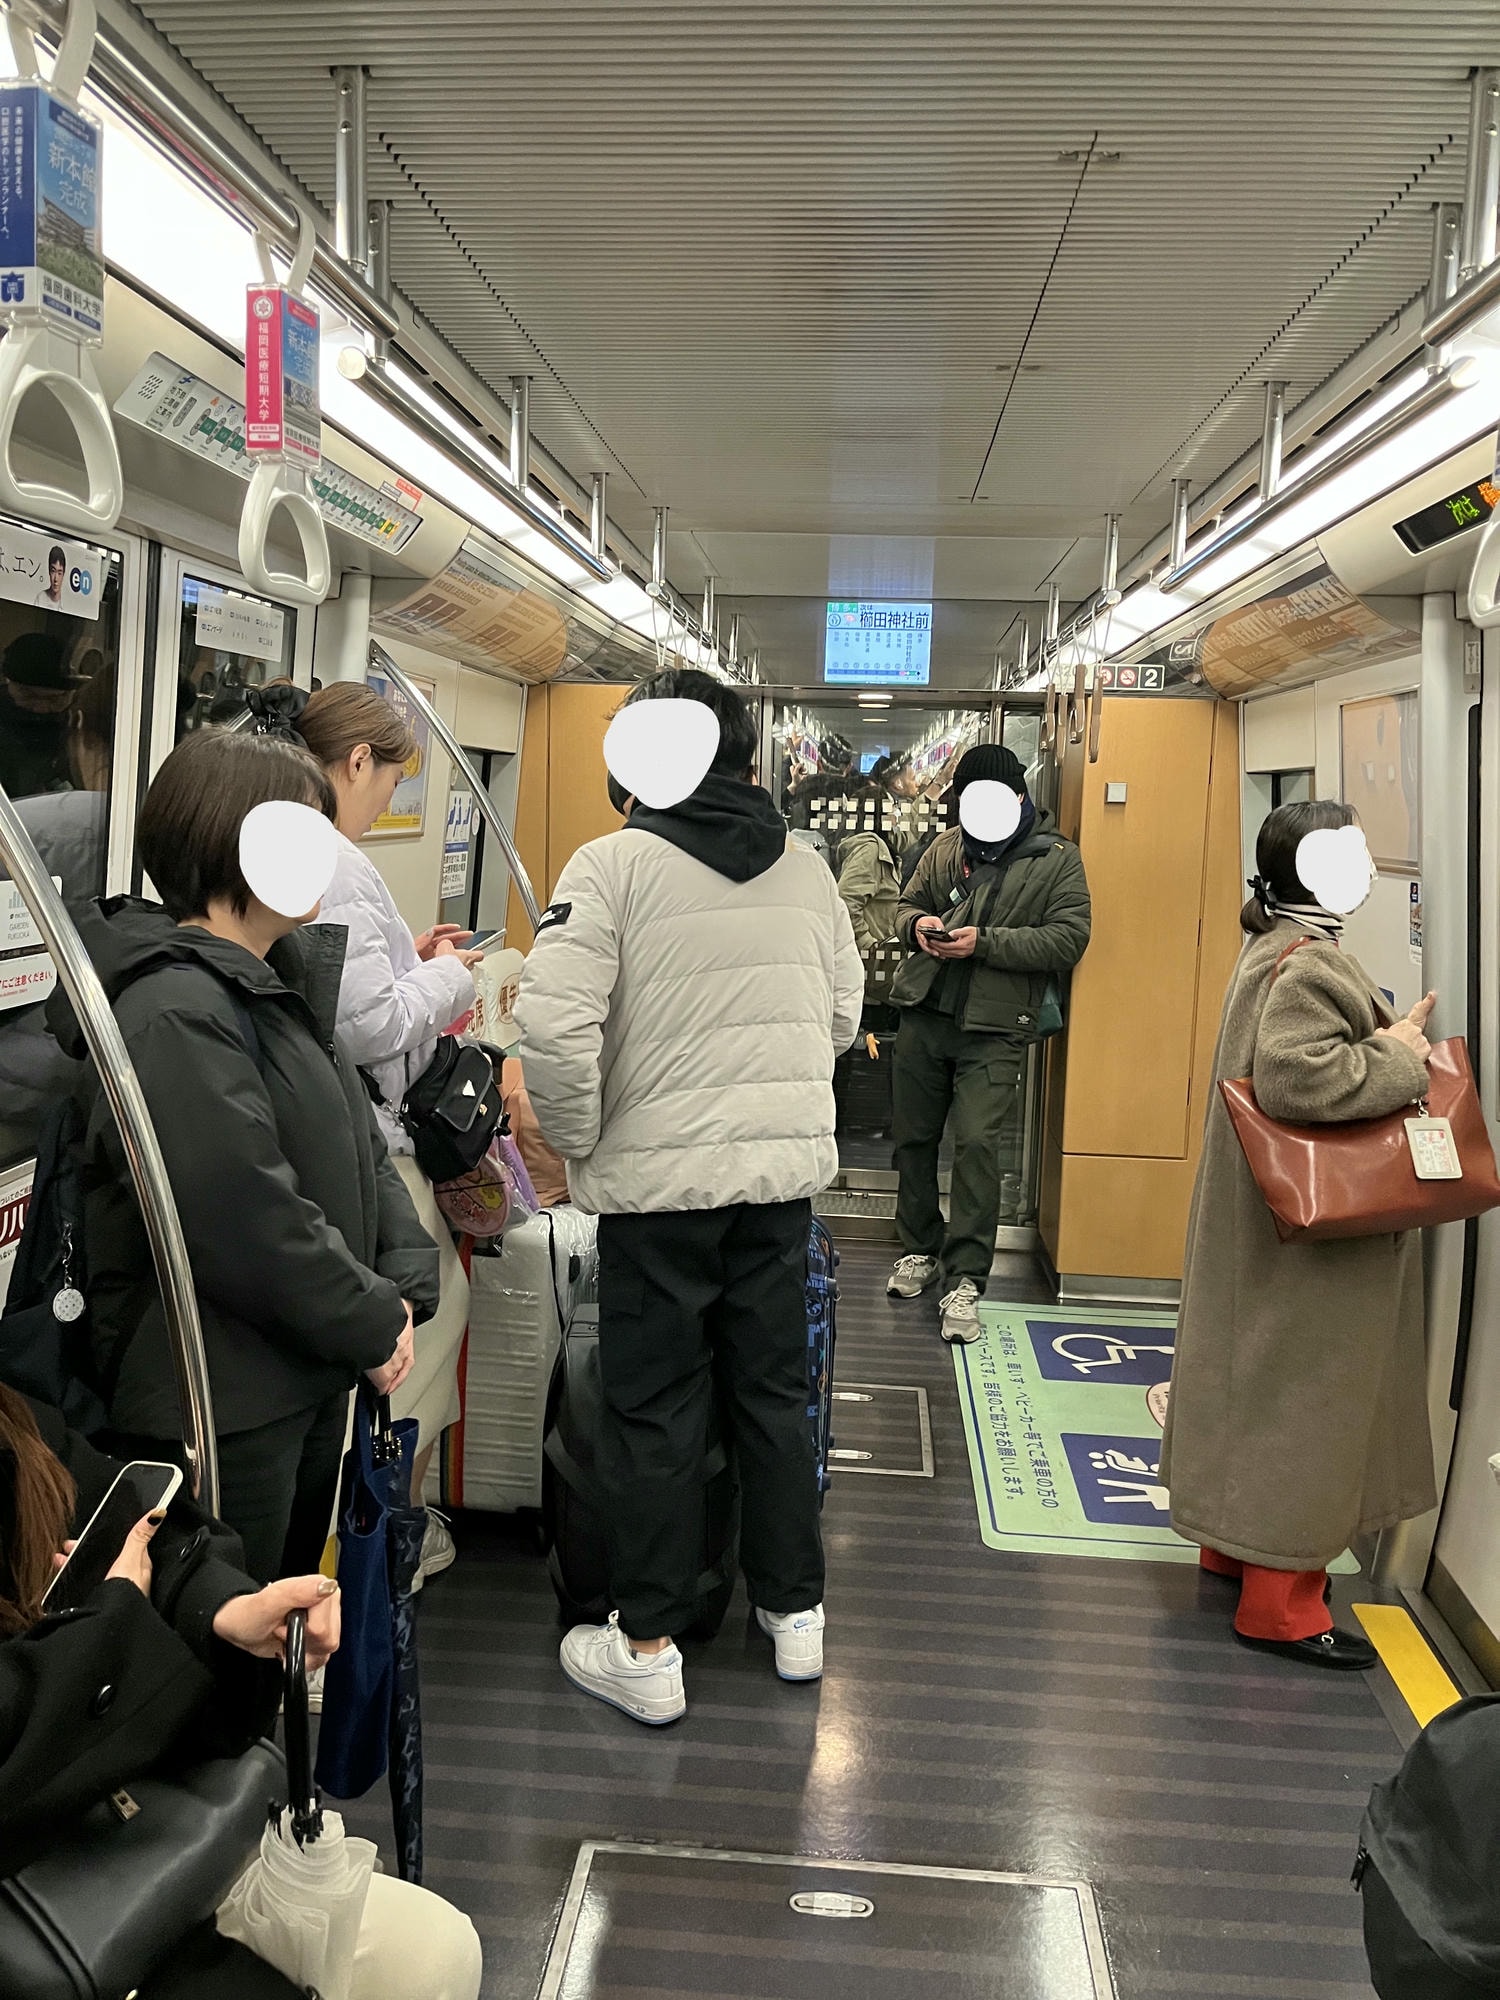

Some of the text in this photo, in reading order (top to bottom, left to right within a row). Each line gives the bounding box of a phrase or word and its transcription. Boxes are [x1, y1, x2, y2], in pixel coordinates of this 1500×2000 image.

[43, 275, 101, 318] 福岡歯科大学
[860, 611, 930, 629] 櫛田神社前
[1144, 668, 1159, 688] 2
